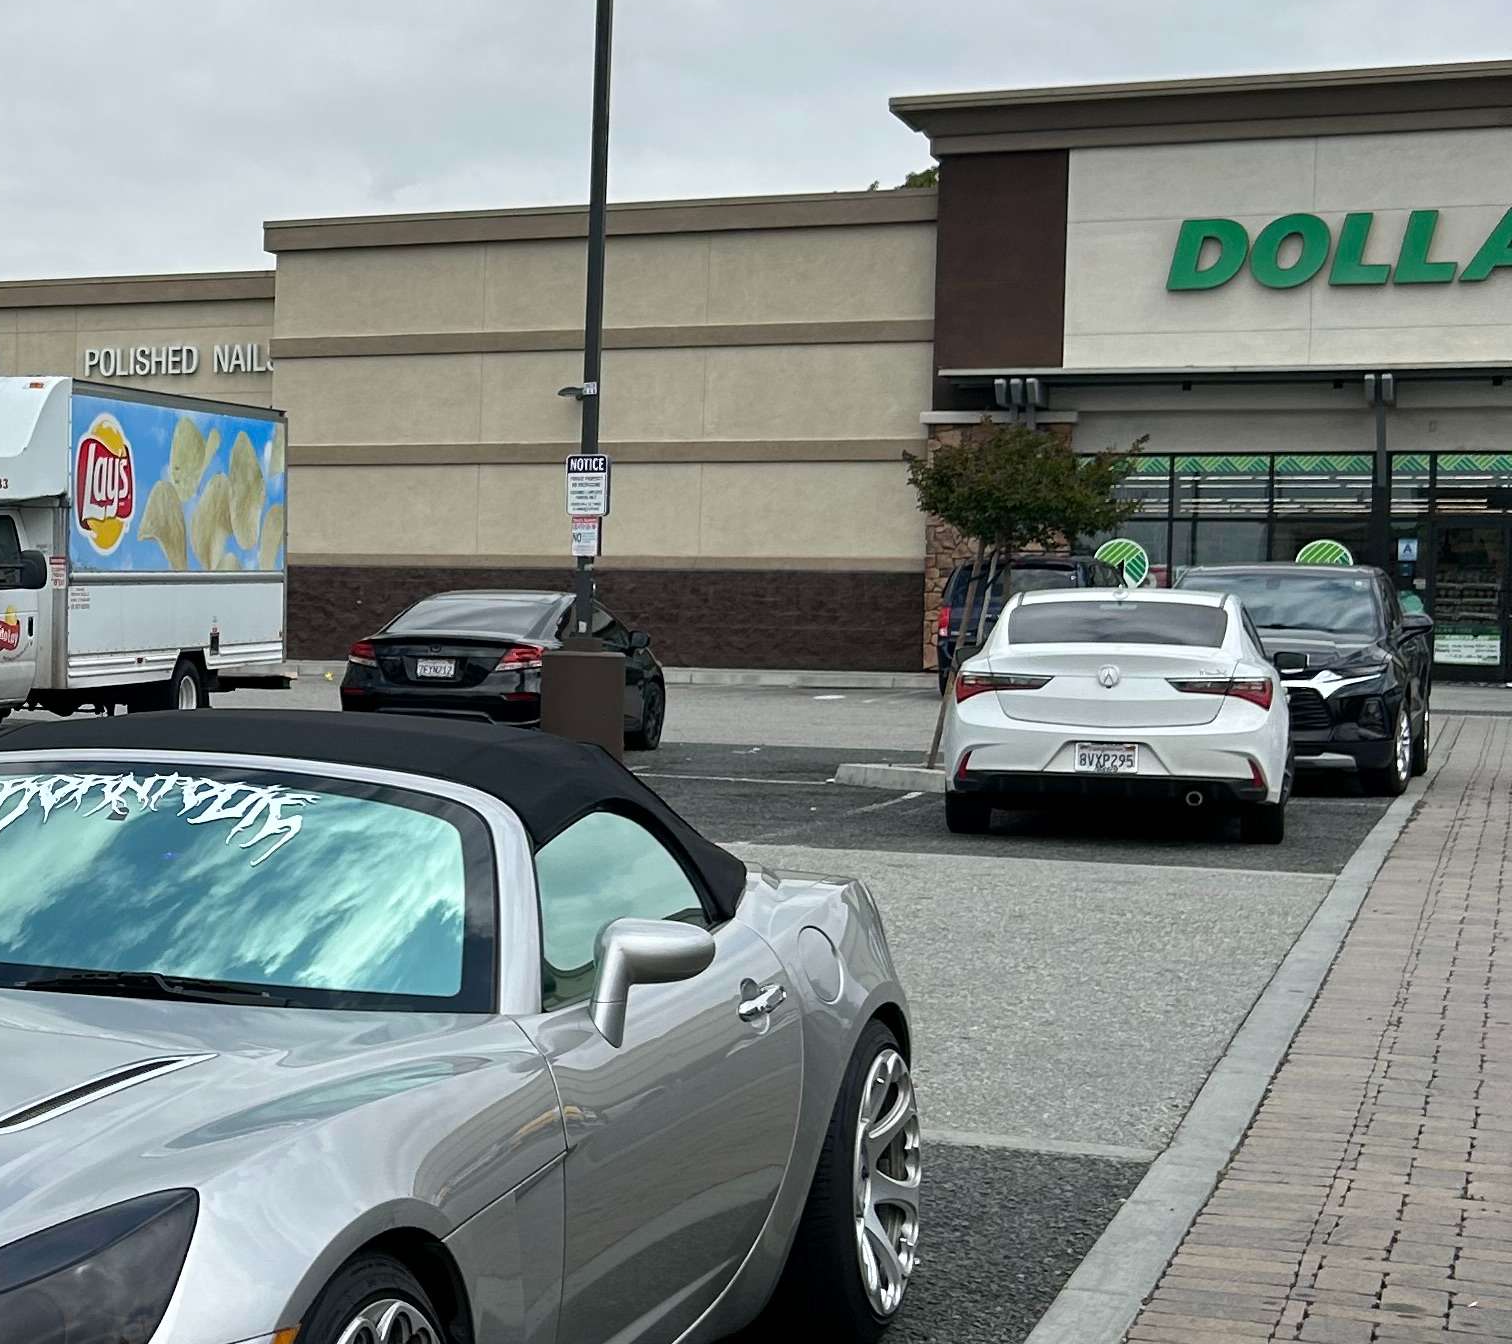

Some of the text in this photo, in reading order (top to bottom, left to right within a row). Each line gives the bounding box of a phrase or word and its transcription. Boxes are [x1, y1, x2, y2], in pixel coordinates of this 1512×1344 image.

[84, 346, 199, 377] POLISHED
[569, 457, 605, 472] NOTICE
[1402, 543, 1413, 554] A
[1079, 752, 1134, 769] 8VXP295
